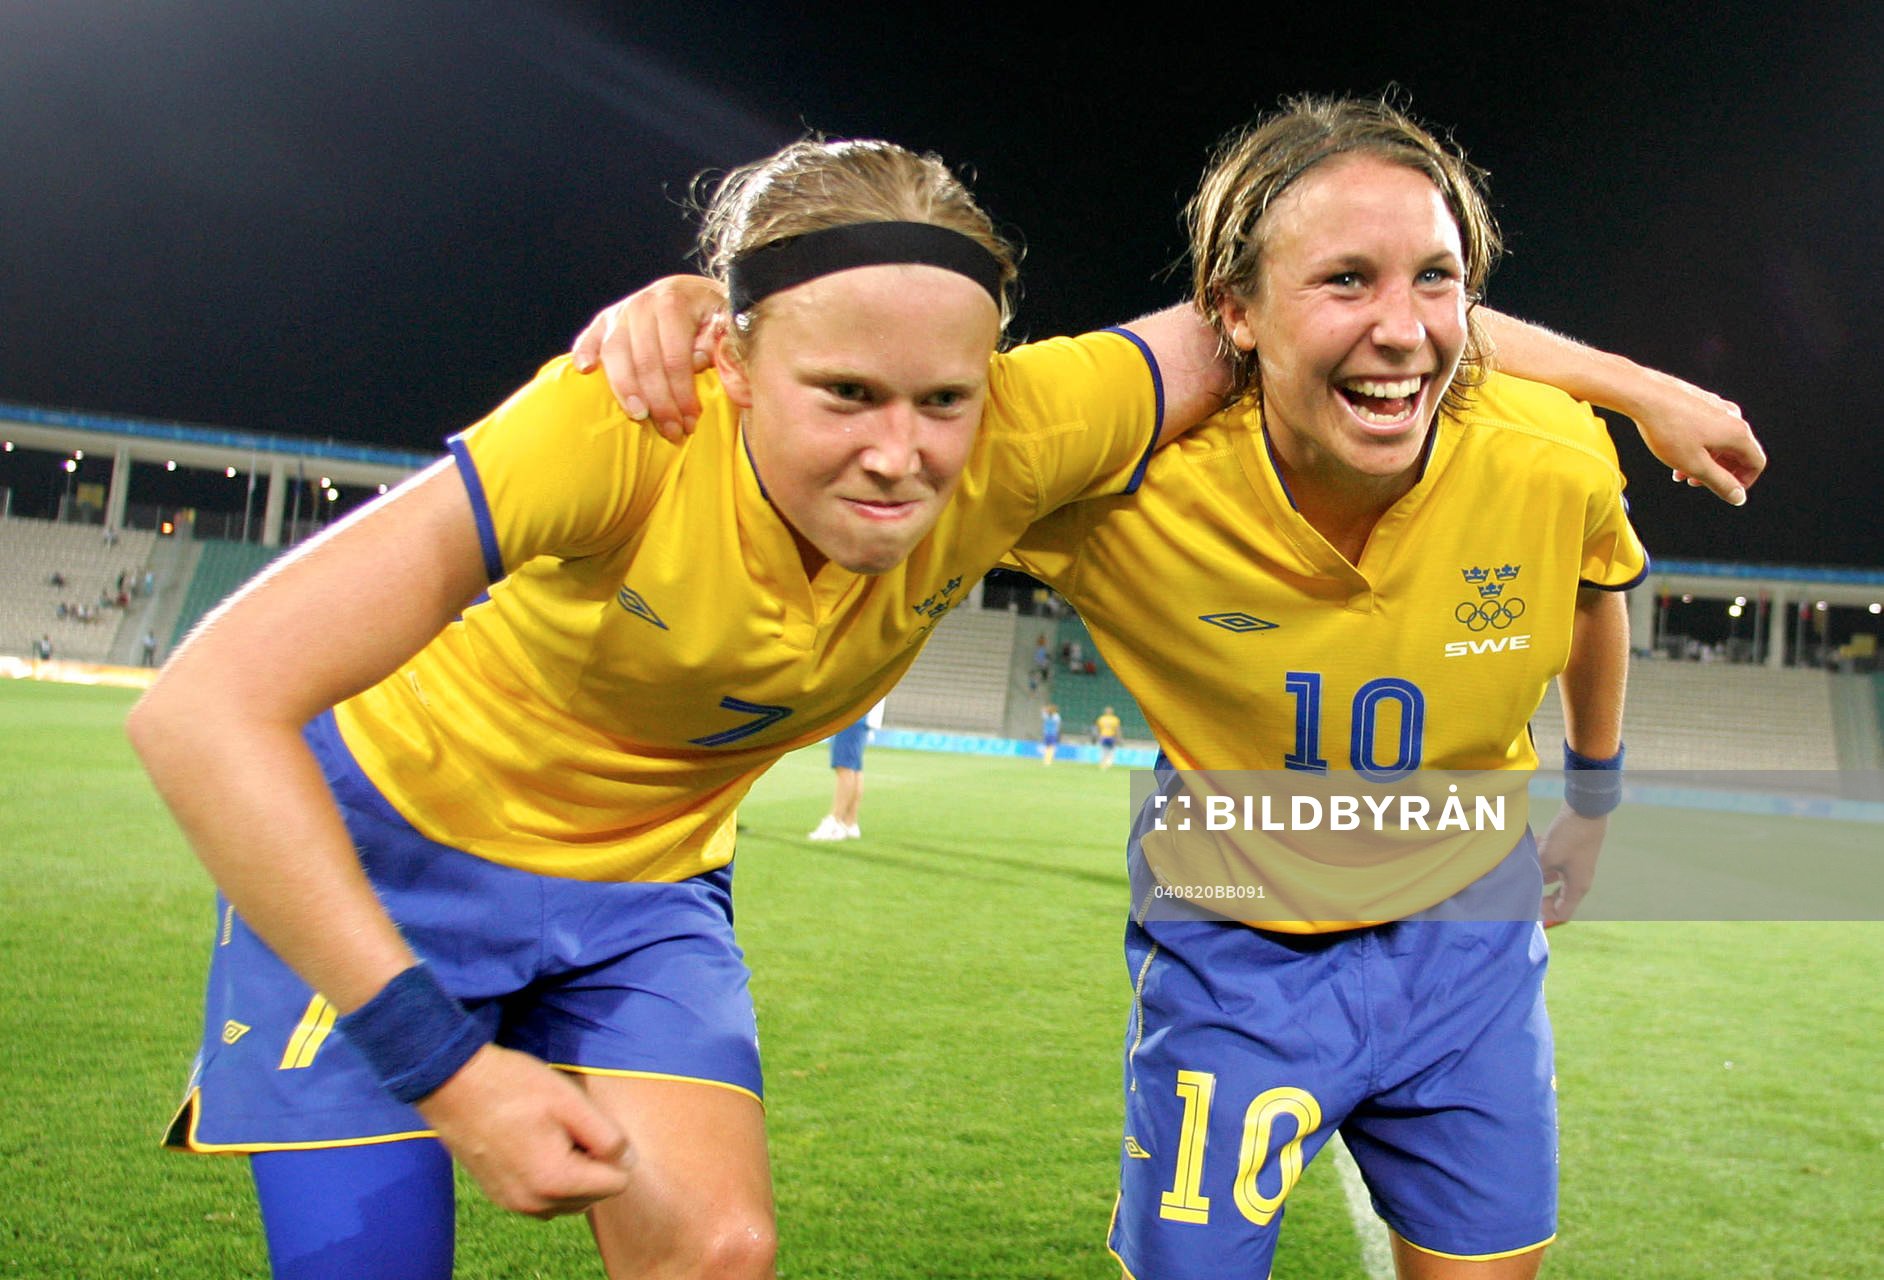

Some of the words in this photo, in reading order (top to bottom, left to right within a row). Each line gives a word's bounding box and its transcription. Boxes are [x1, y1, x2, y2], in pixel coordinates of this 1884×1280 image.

[1444, 634, 1531, 657] SWE
[688, 696, 794, 746] 7
[1285, 671, 1425, 784] 10
[1159, 1069, 1322, 1226] 10
